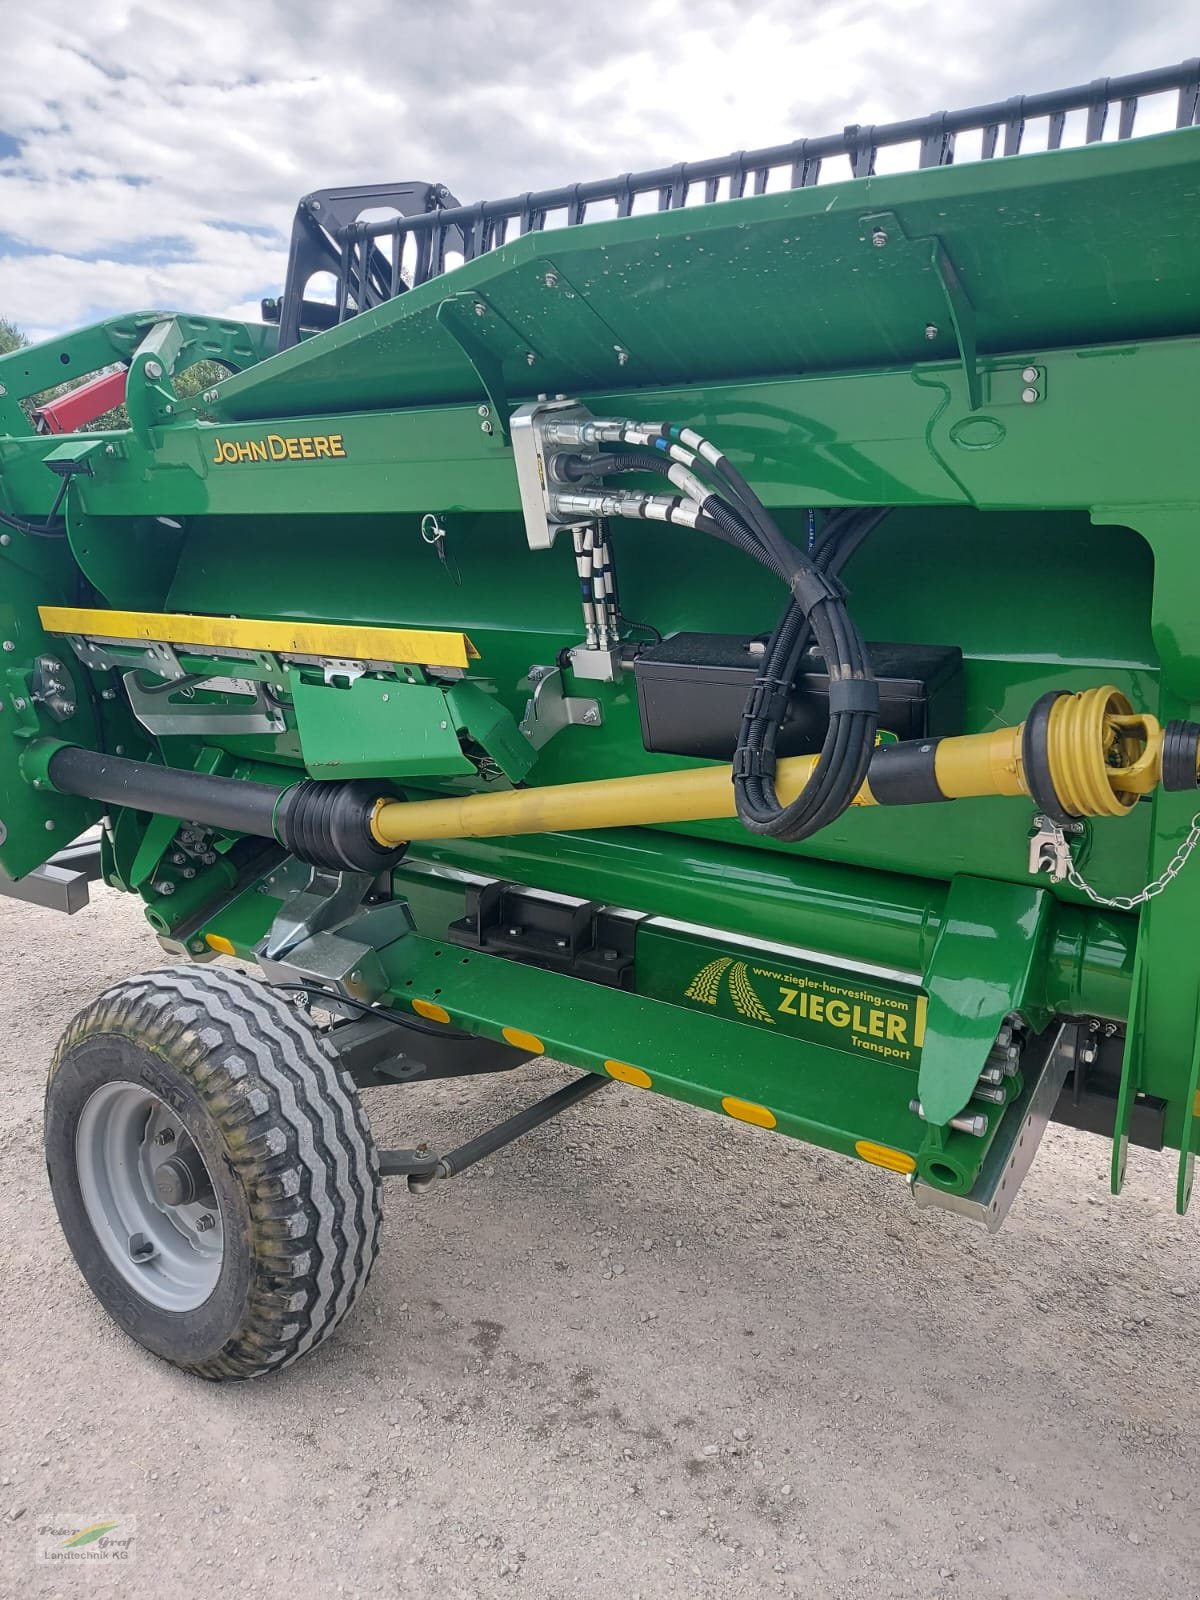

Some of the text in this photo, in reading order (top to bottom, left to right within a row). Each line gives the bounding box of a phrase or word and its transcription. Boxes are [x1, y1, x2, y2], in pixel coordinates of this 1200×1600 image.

[213, 434, 347, 464] JOHN DEERE
[752, 967, 909, 1011] www.ziegler-harvesting.com
[777, 986, 908, 1044] ZIEGLER
[851, 1035, 911, 1060] Transport
